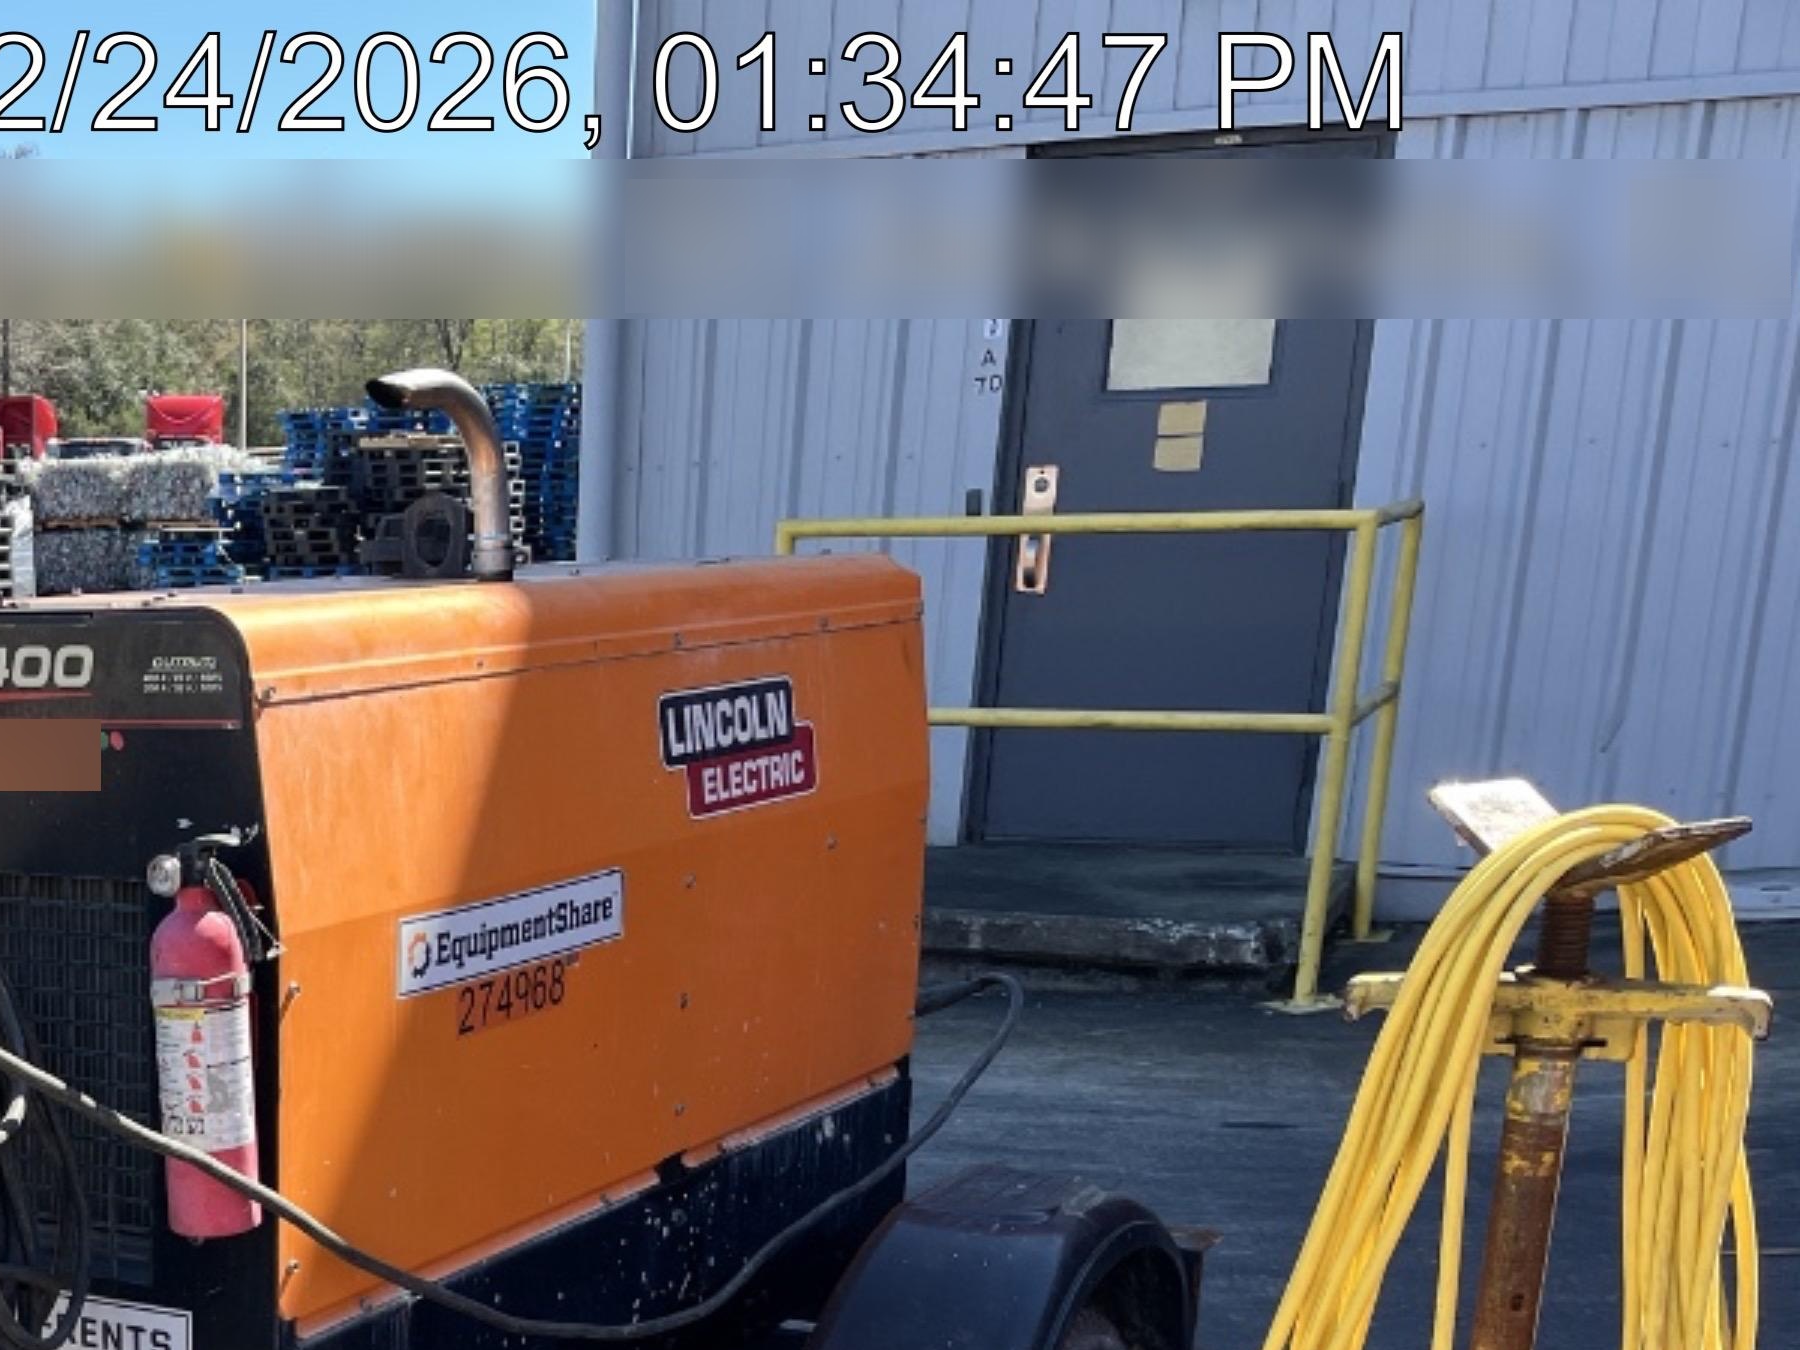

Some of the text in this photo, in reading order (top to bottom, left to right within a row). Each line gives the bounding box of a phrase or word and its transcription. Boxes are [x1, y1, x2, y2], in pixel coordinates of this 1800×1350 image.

[664, 690, 788, 757] LINCOLN
[702, 750, 805, 804] ELECTRIC
[434, 896, 613, 979] EquipmentShare
[458, 959, 566, 1036] 274968
